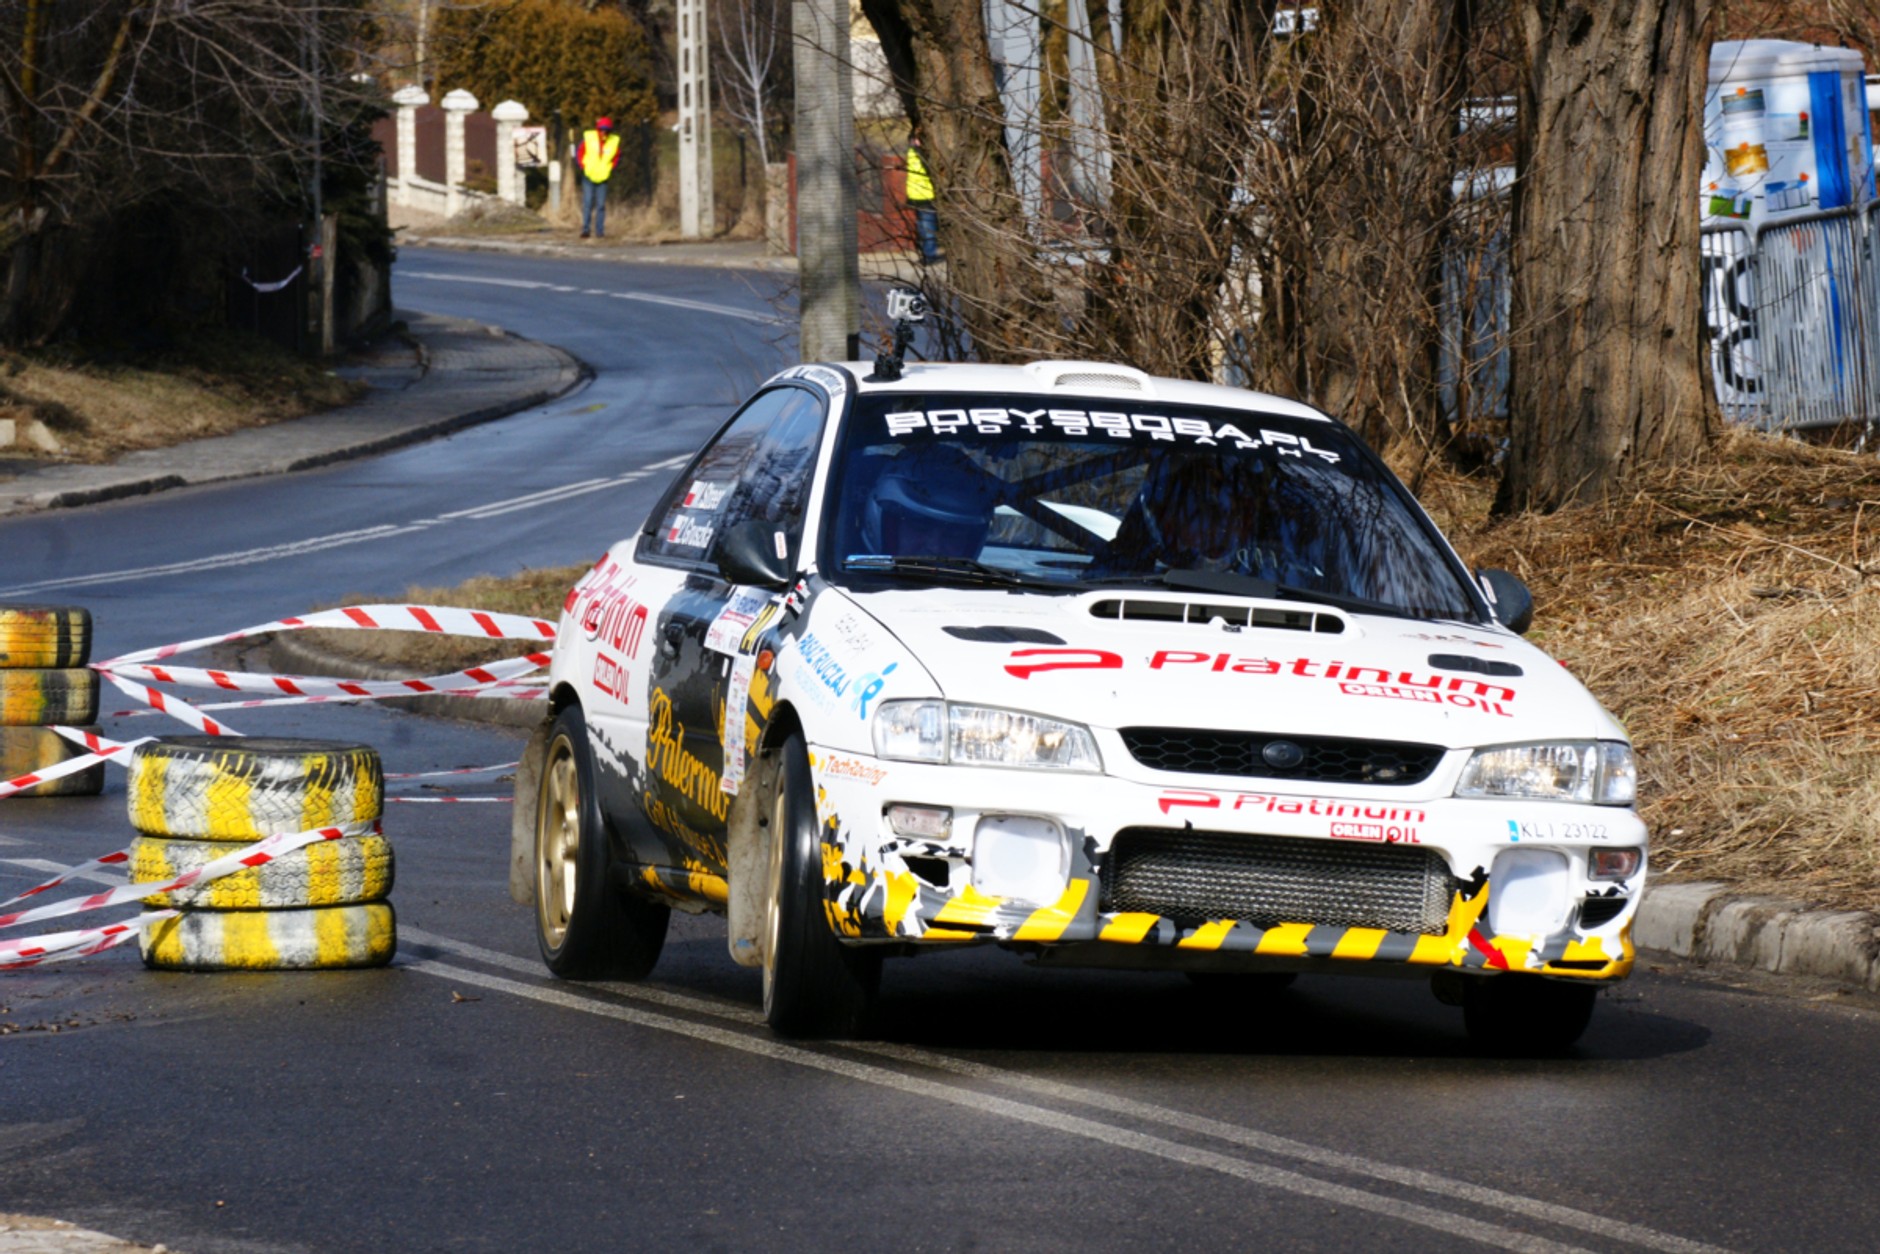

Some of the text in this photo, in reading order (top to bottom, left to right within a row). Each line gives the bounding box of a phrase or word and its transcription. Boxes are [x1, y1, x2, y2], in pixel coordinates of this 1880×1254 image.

[885, 408, 1340, 459] BORYSBOBA.PL
[1149, 650, 1516, 702] Platinum
[1341, 682, 1514, 717] ORLEN OIL
[646, 686, 730, 823] Palermo
[1233, 794, 1426, 823] Platinum
[1331, 822, 1421, 844] ORLEN OIL
[1562, 822, 1608, 840] 23122
